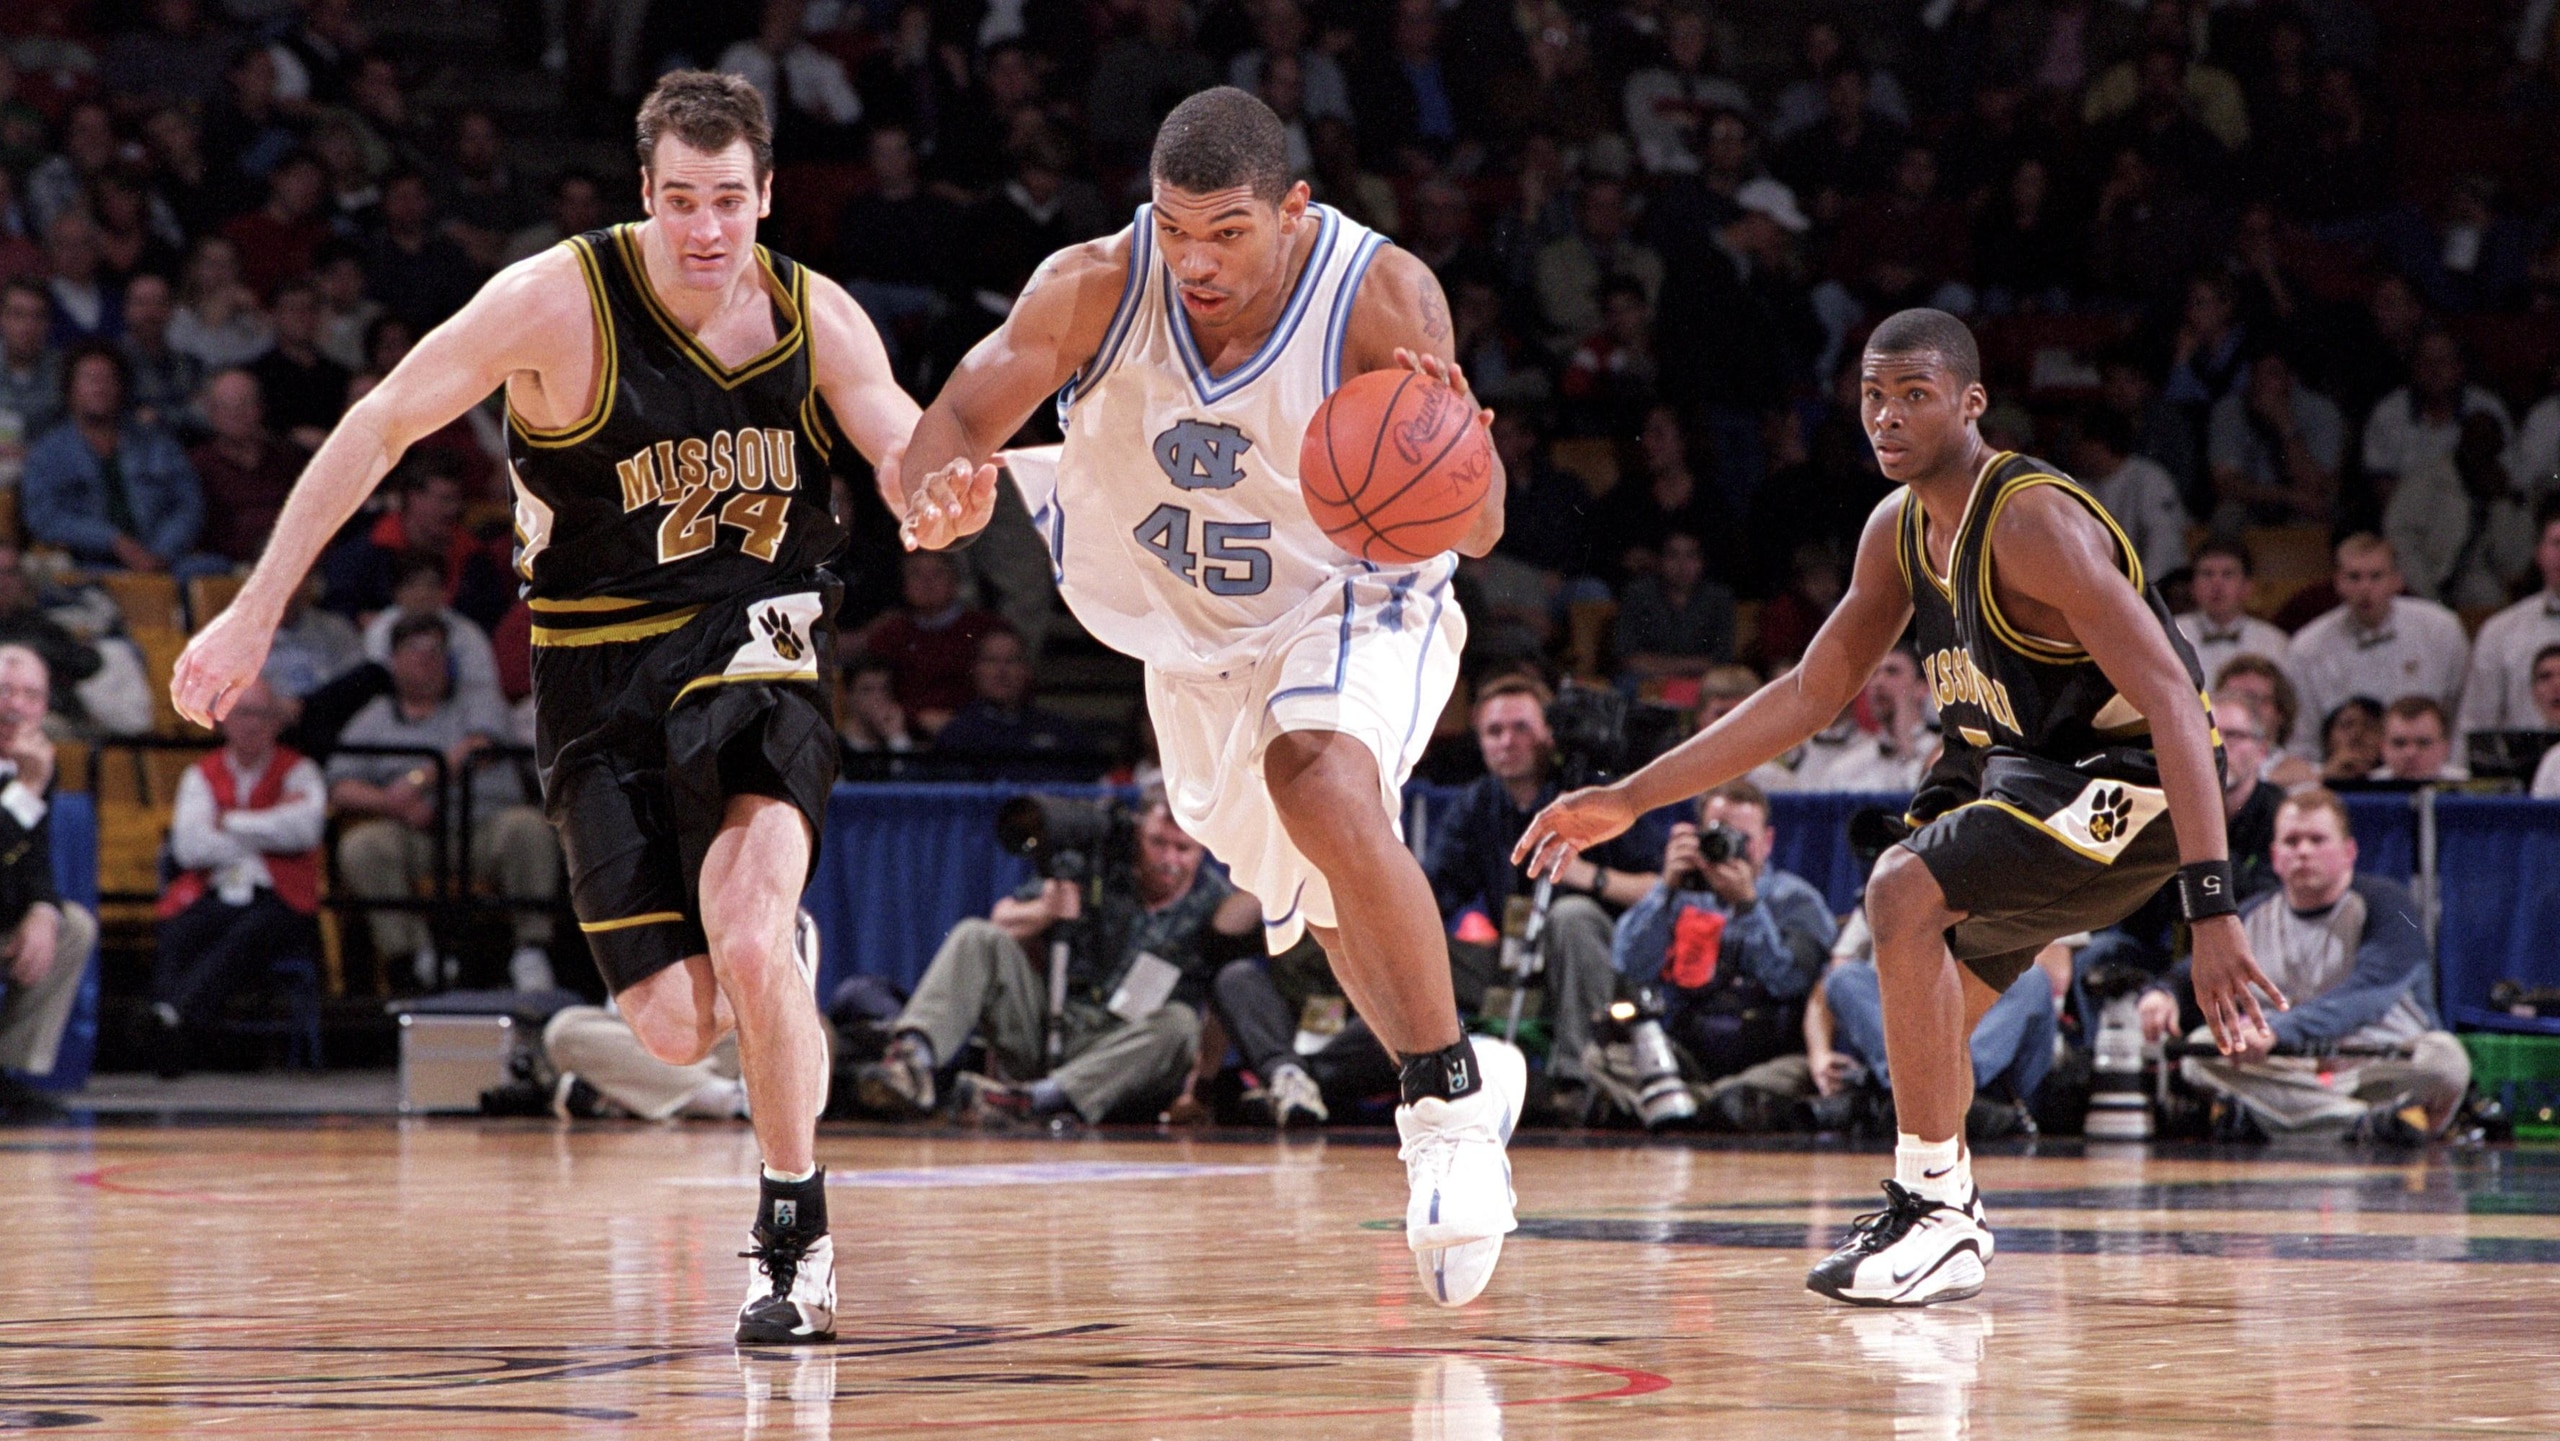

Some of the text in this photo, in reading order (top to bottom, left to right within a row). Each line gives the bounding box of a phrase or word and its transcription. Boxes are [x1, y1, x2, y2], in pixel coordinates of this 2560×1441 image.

[657, 484, 792, 565] 24
[1133, 503, 1272, 596] 45
[2203, 875, 2221, 896] 5
